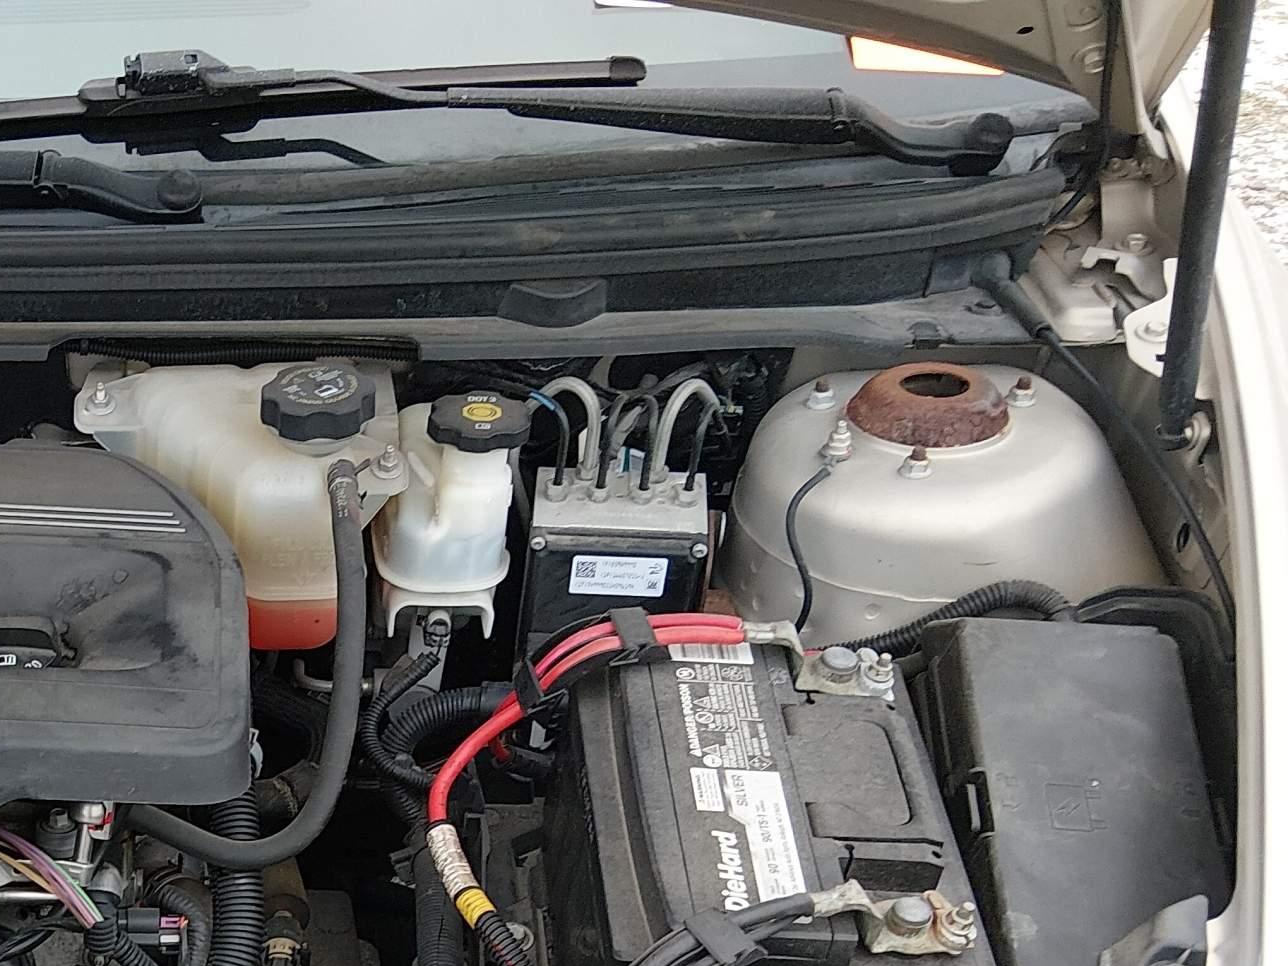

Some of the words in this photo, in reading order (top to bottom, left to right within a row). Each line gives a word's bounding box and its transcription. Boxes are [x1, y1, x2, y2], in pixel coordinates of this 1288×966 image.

[466, 395, 488, 403] DOT
[678, 683, 694, 714] POISON
[685, 715, 700, 749] DANGER
[731, 775, 749, 807] SILVER
[711, 830, 750, 911] DieHard
